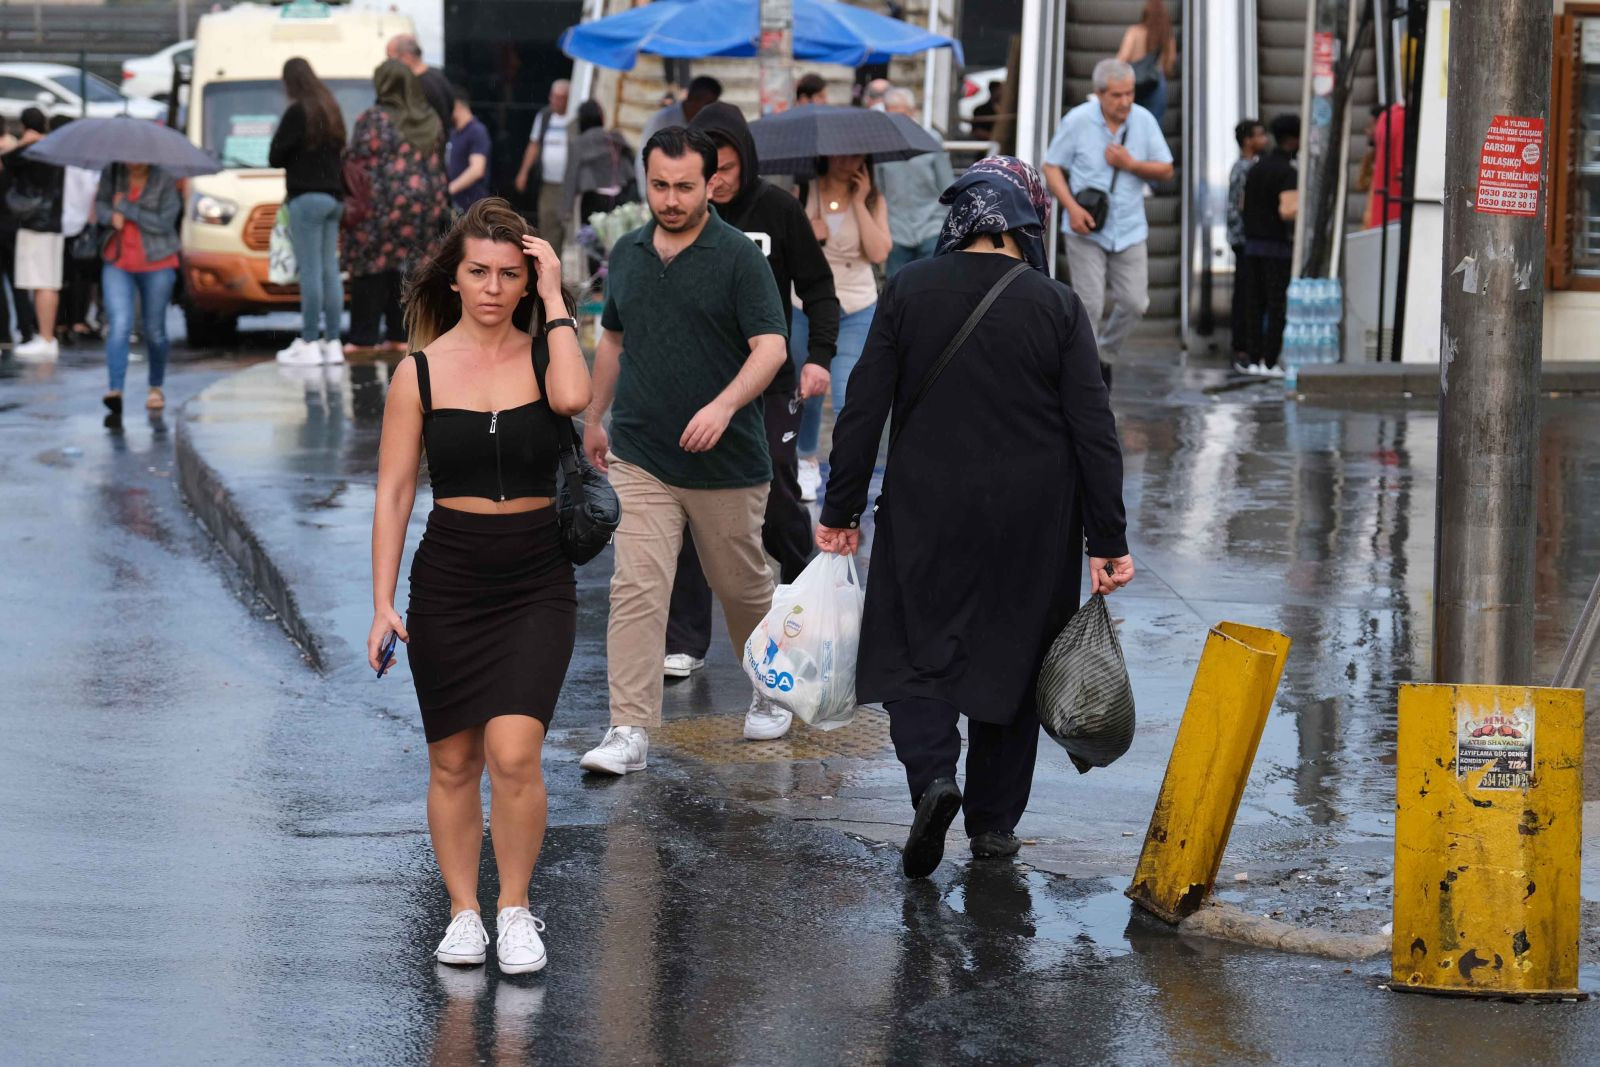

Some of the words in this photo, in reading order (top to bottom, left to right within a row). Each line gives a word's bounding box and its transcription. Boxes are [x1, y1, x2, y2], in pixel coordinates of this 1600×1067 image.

[1484, 142, 1515, 152] GARSON
[1483, 156, 1522, 169] BULAŞIKÇI
[1481, 170, 1495, 178] KAT
[1480, 188, 1500, 196] 0530
[1479, 198, 1499, 206] 0530
[1507, 761, 1527, 769] 7/24
[1497, 774, 1510, 786] 745
